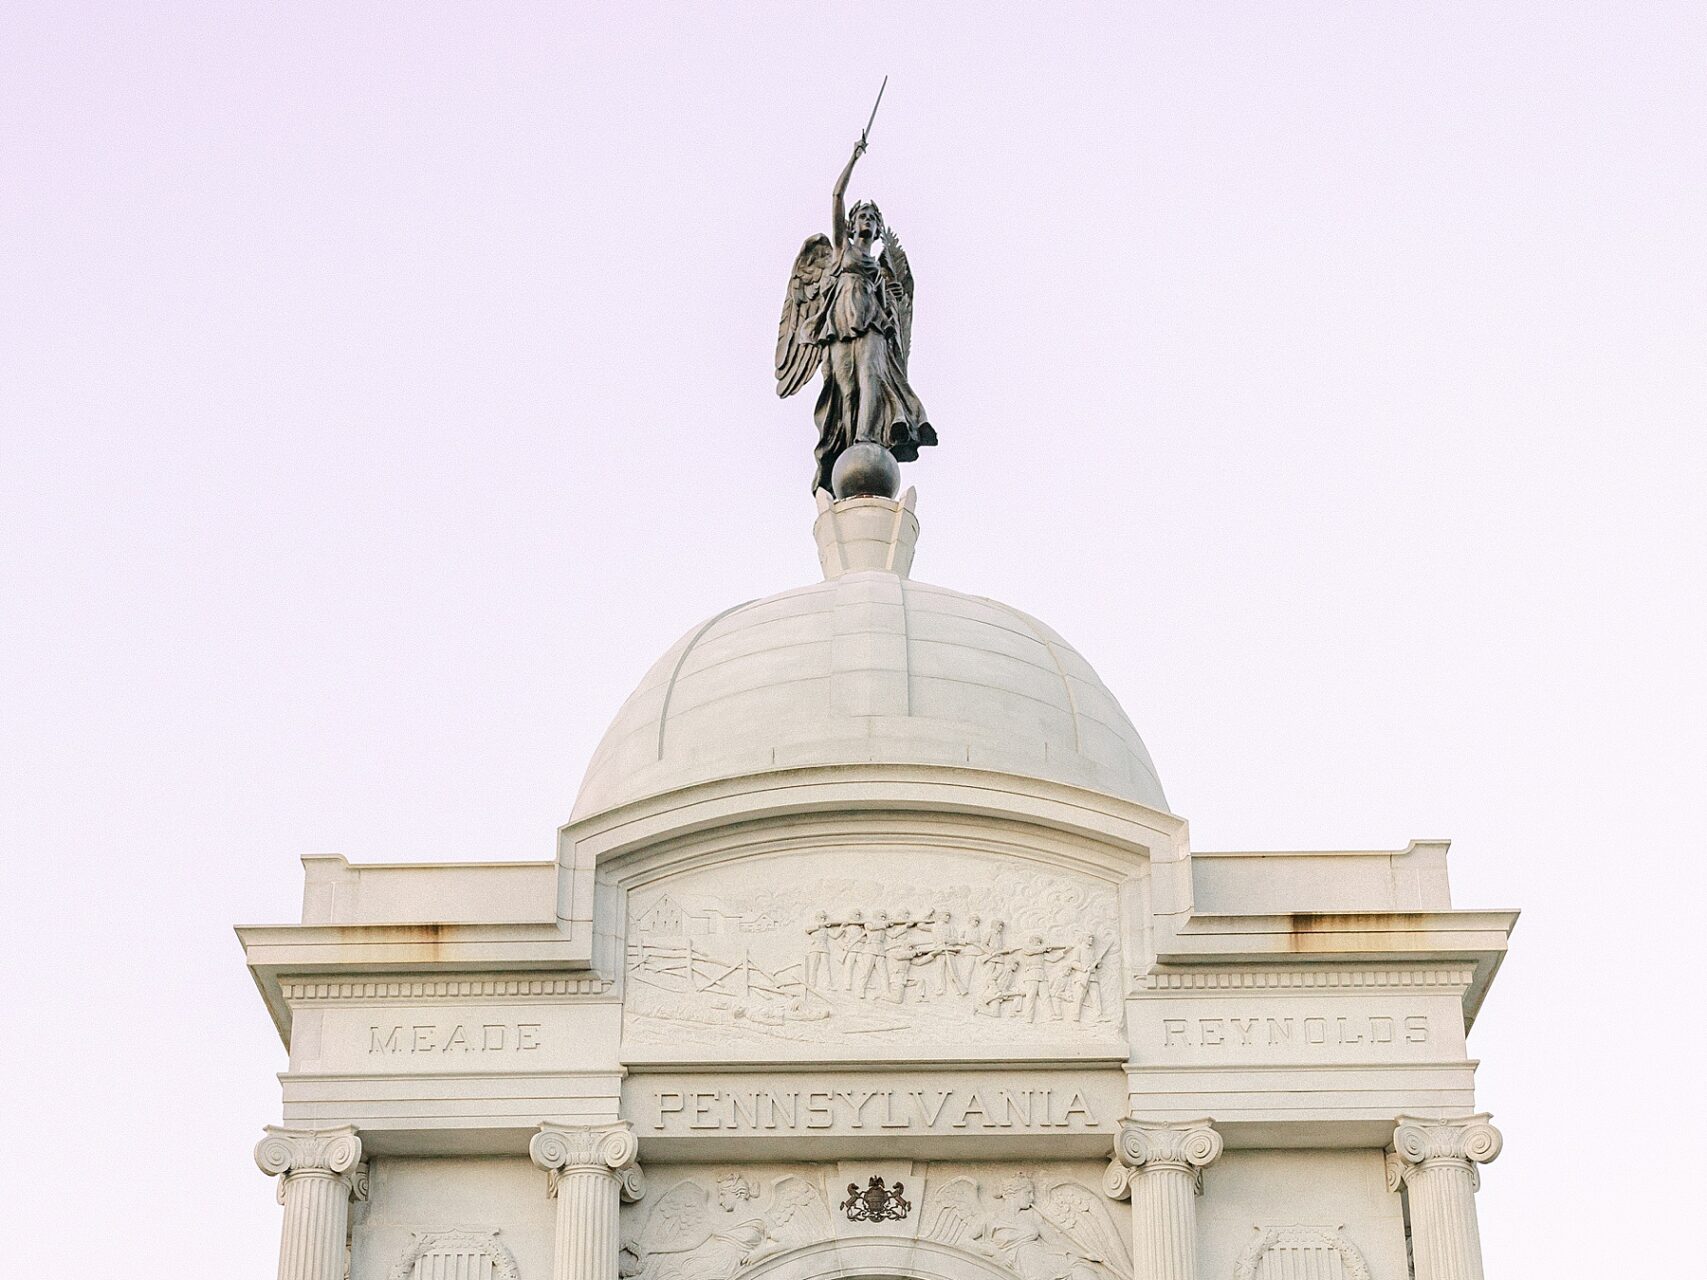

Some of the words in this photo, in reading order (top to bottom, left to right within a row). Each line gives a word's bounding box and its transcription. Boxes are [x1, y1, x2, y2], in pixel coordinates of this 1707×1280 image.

[369, 1024, 541, 1054] MEADE
[1163, 1016, 1429, 1046] REYNOLDS
[654, 1089, 1099, 1129] PENNSYLVANIA
